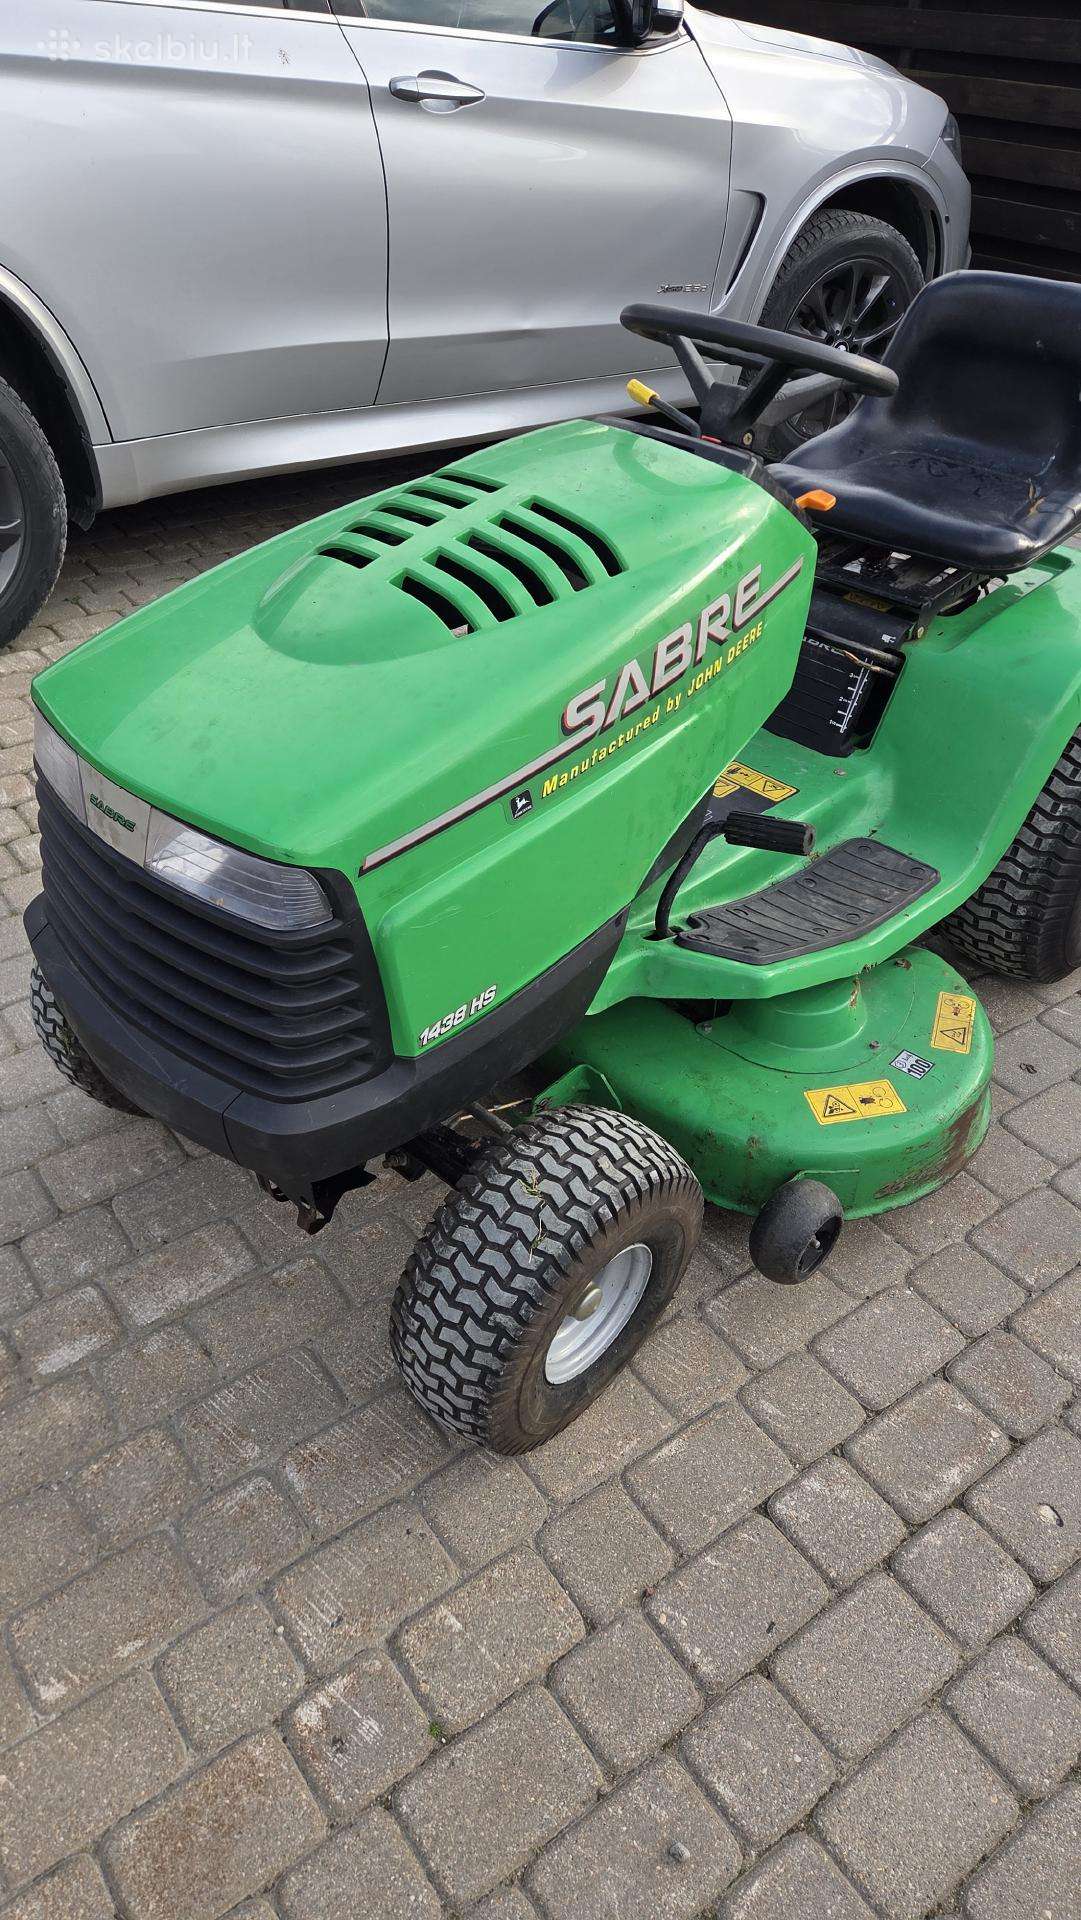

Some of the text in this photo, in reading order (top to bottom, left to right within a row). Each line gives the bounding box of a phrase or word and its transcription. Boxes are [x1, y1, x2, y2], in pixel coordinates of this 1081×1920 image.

[562, 563, 763, 744] SABRE
[541, 620, 764, 799] Manufactured by JOHN DEERE
[89, 793, 137, 832] SABRE
[418, 984, 498, 1047] 1438 HS
[907, 1059, 932, 1077] 100
